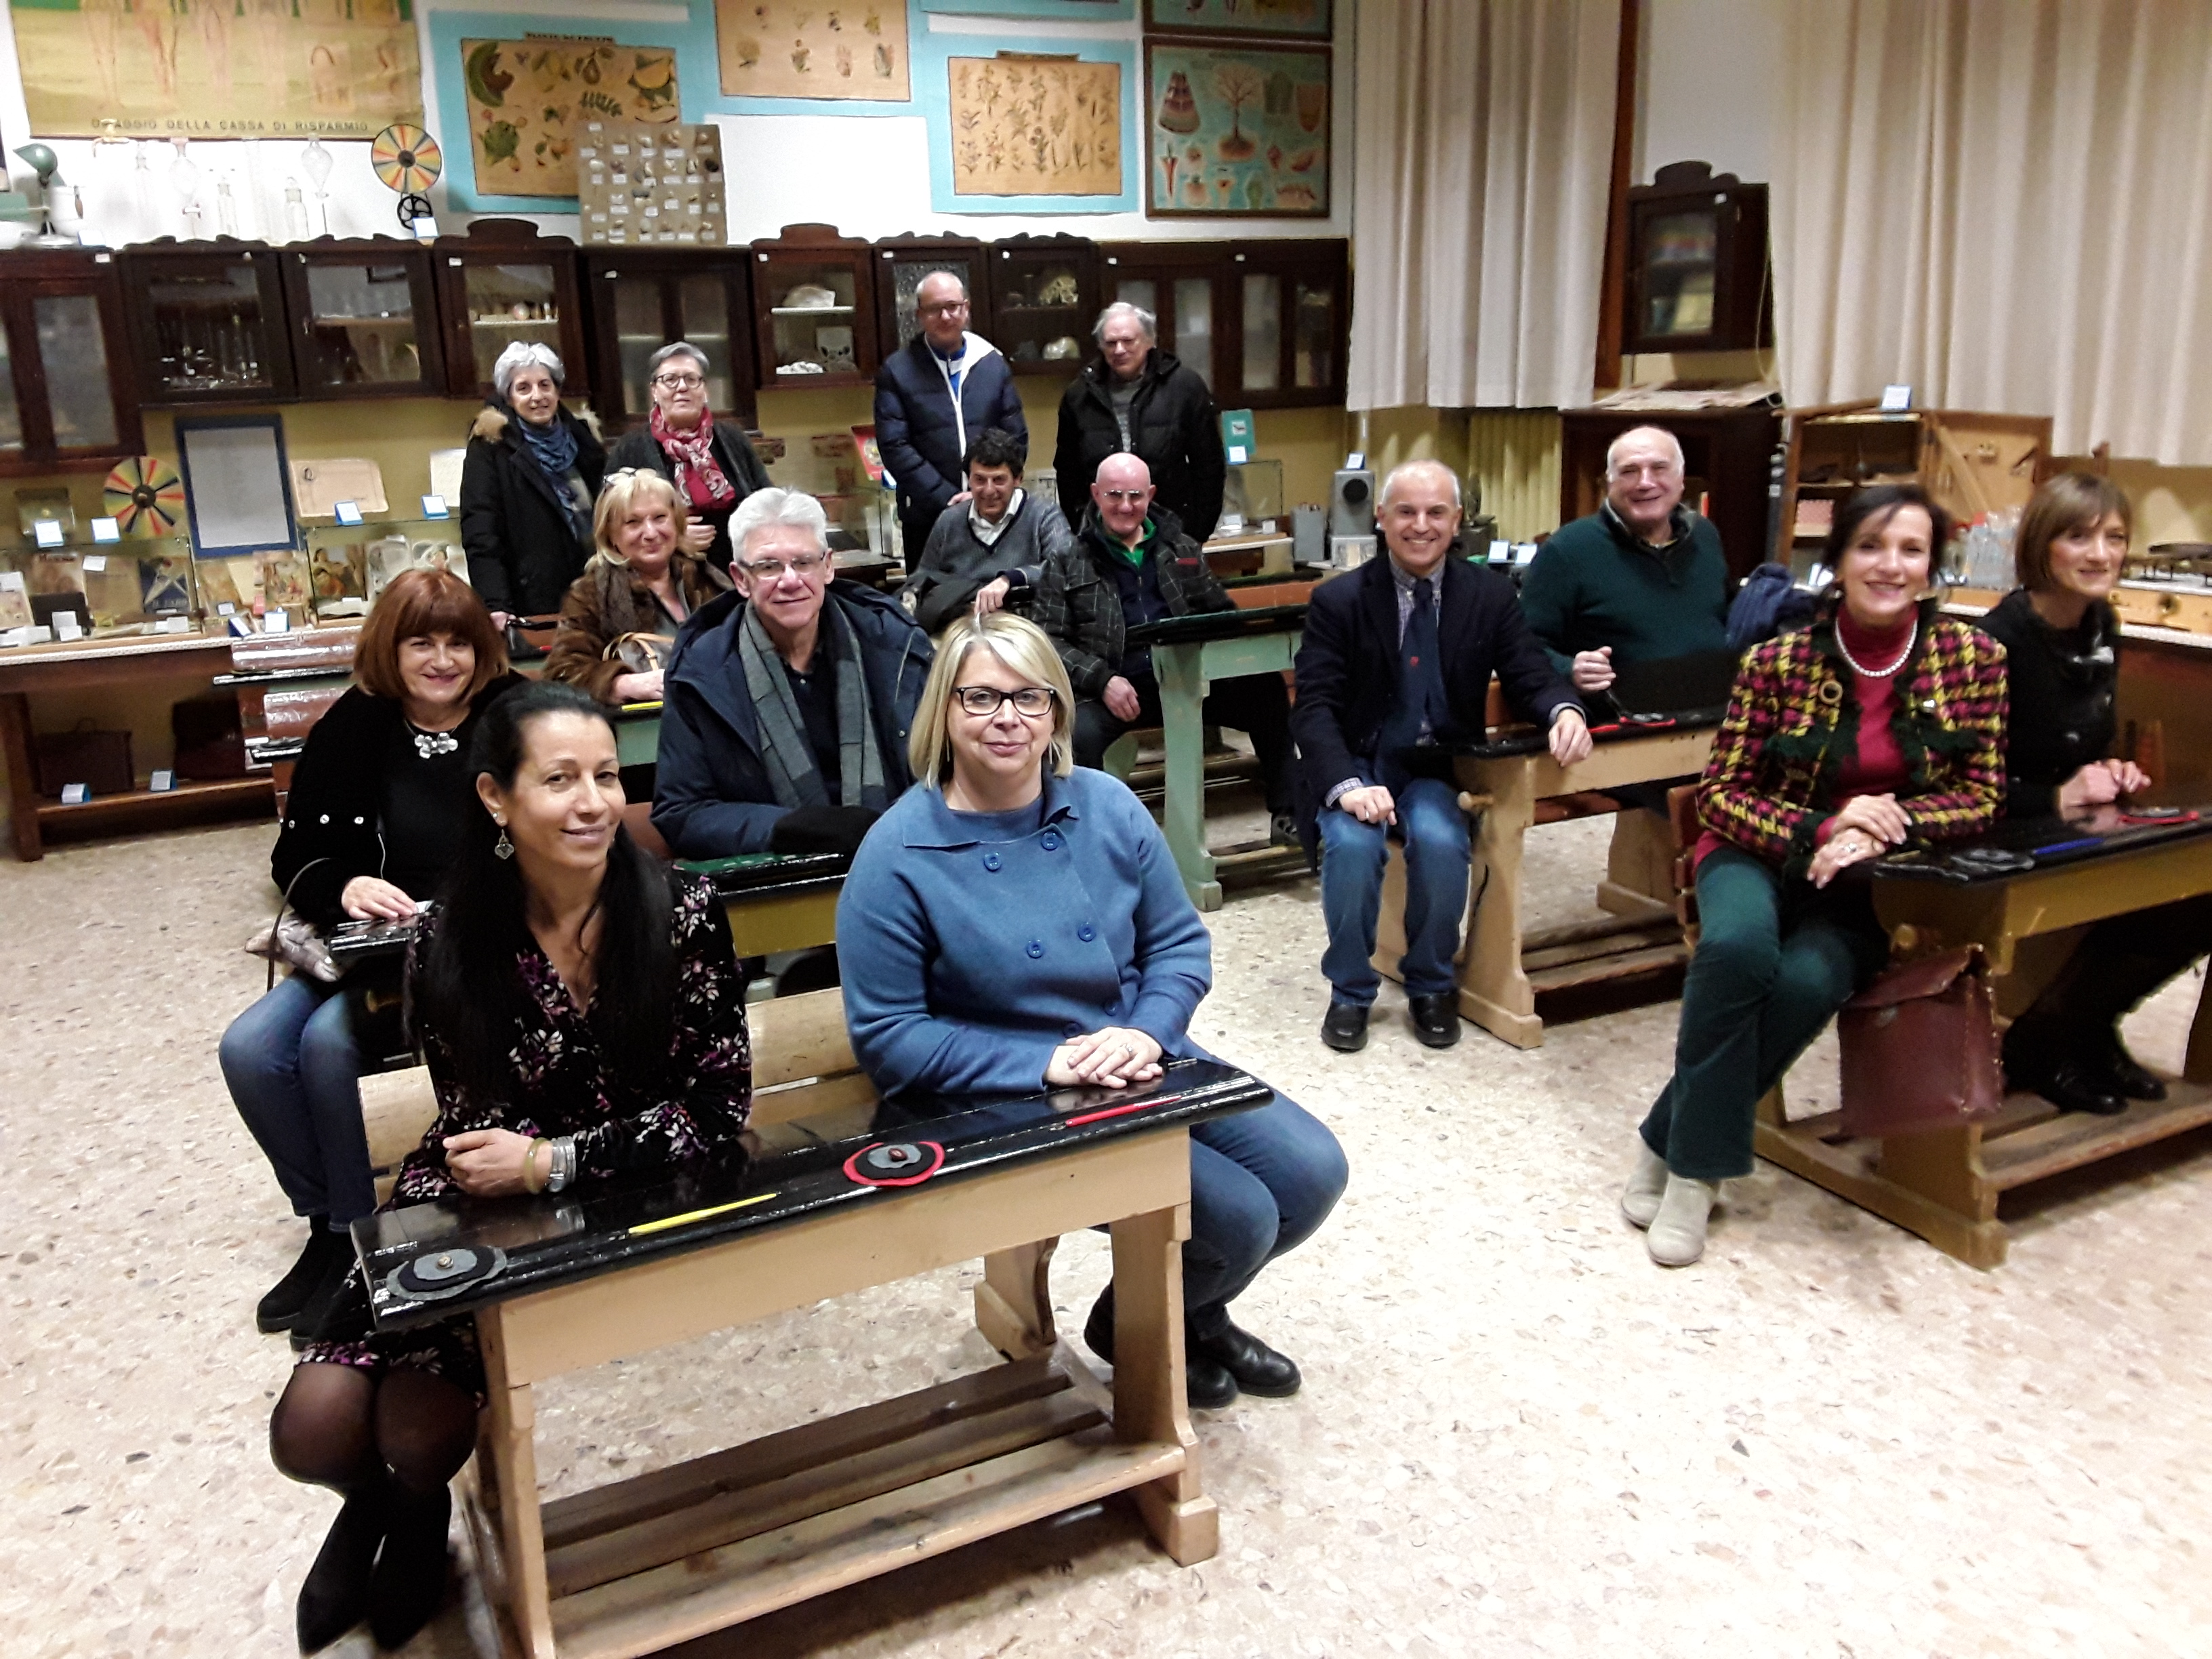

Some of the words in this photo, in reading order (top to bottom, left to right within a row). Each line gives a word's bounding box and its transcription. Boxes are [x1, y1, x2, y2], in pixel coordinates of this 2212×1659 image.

[91, 119, 157, 129] OAGGIO
[167, 120, 211, 130] DELLA
[219, 121, 264, 131] CASSA
[273, 121, 286, 130] DI
[295, 121, 368, 131] RISPARMIO
